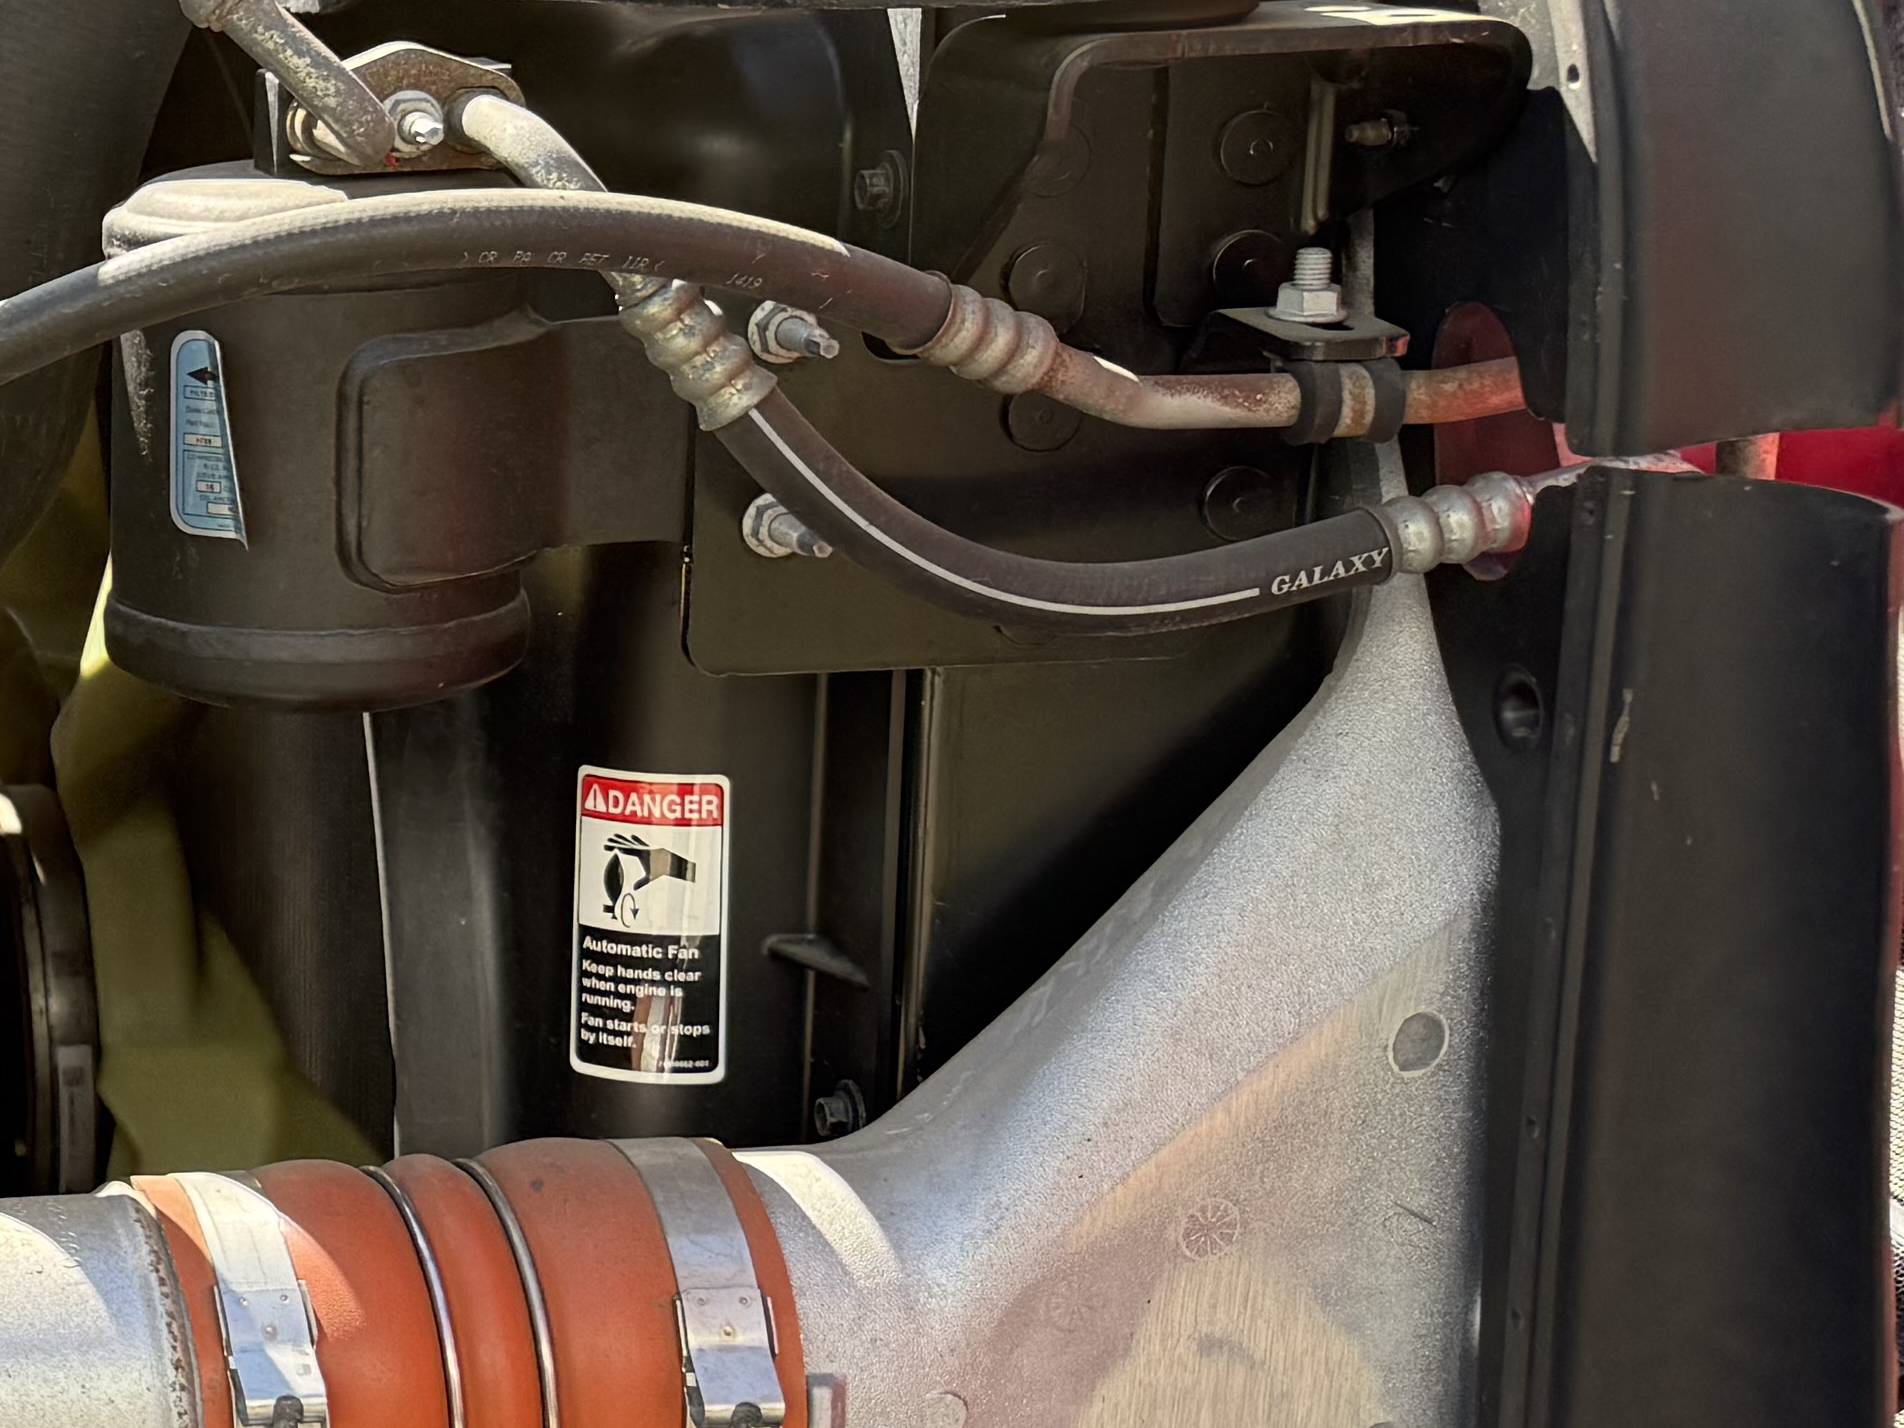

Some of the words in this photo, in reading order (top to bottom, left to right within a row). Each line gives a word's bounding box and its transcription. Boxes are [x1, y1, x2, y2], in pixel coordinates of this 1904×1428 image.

[1271, 546, 1390, 595] GALAXY
[608, 789, 719, 820] DANGER
[583, 935, 663, 959] Automatic
[667, 945, 699, 960] Fan
[582, 959, 614, 977] Keep
[617, 965, 661, 981] hands
[664, 969, 702, 982] clear
[581, 977, 615, 993] when
[618, 984, 667, 998] engine
[670, 985, 683, 998] is
[581, 992, 635, 1013] running.
[581, 1012, 603, 1028] Fan
[606, 1018, 648, 1034] starts
[651, 1024, 667, 1036] or
[671, 1022, 711, 1038] stops
[581, 1028, 597, 1045] by
[598, 1030, 637, 1049] itself.
